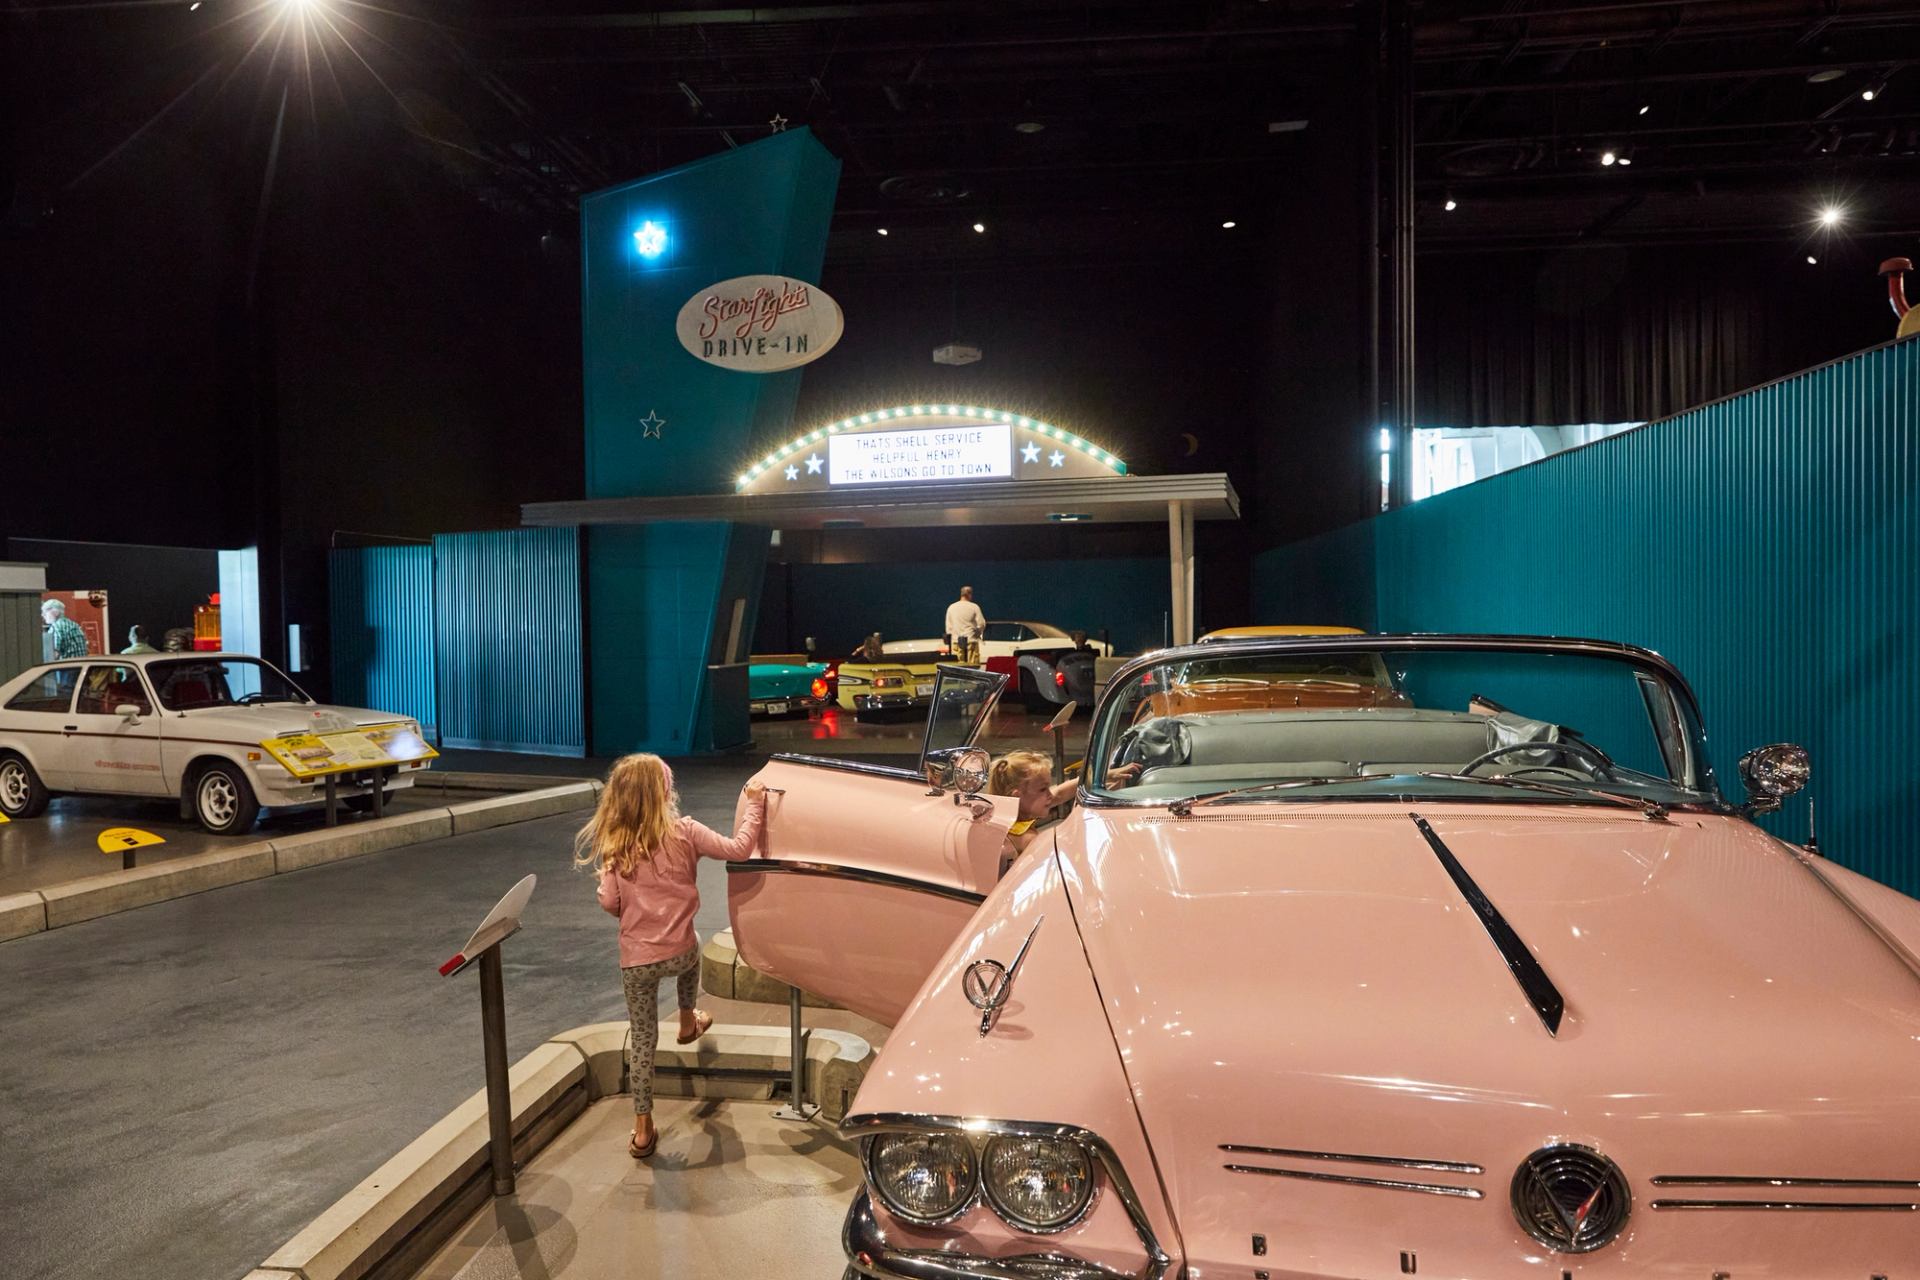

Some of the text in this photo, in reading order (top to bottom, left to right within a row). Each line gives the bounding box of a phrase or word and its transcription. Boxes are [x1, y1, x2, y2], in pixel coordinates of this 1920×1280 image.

[703, 334, 808, 358] DRIVE-IN
[857, 432, 982, 448] THATS SHELL SERVICE
[873, 449, 961, 463] HELPFUL HENRY
[845, 463, 991, 480] THE WILSONS GO TO TOWN
